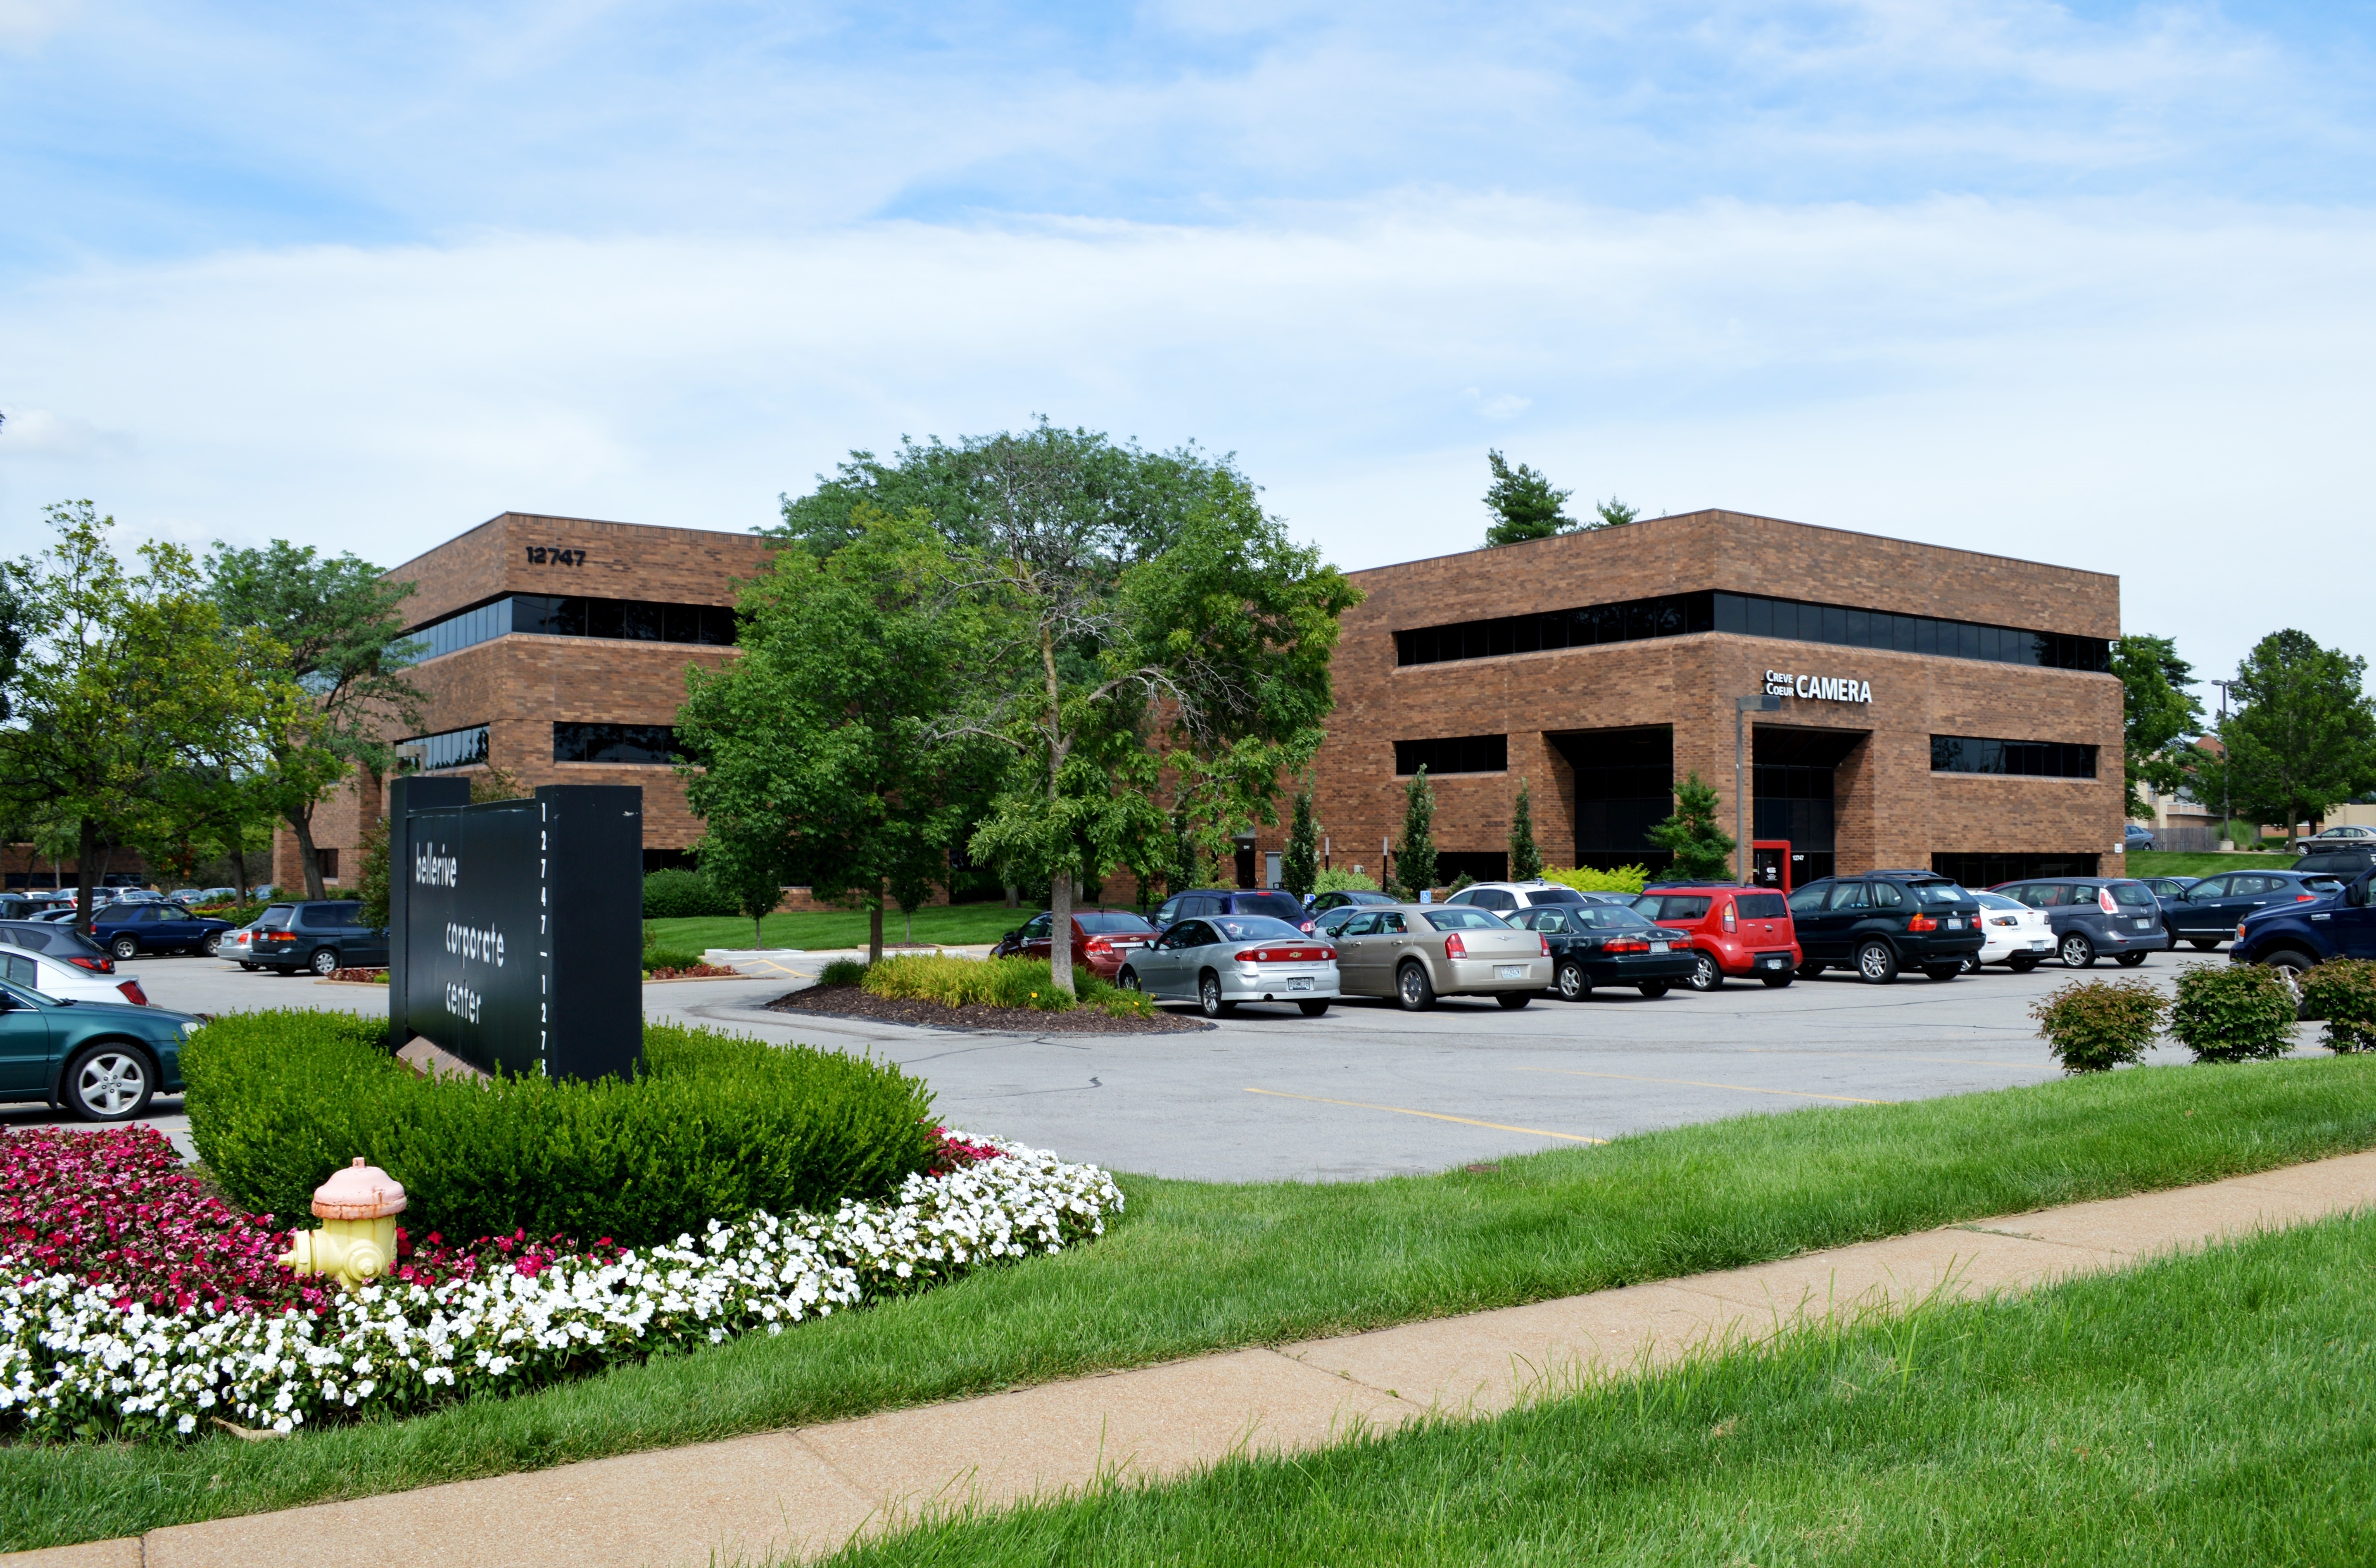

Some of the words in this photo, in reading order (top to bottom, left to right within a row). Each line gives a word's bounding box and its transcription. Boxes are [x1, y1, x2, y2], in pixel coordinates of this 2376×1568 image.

[526, 546, 586, 566] 12747
[1765, 683, 1794, 696] COEUR
[1766, 670, 1793, 684] CREVE
[1796, 675, 1872, 703] CAMERA
[416, 842, 457, 887] bellerive
[446, 922, 504, 968] corporate
[446, 980, 481, 1024] center
